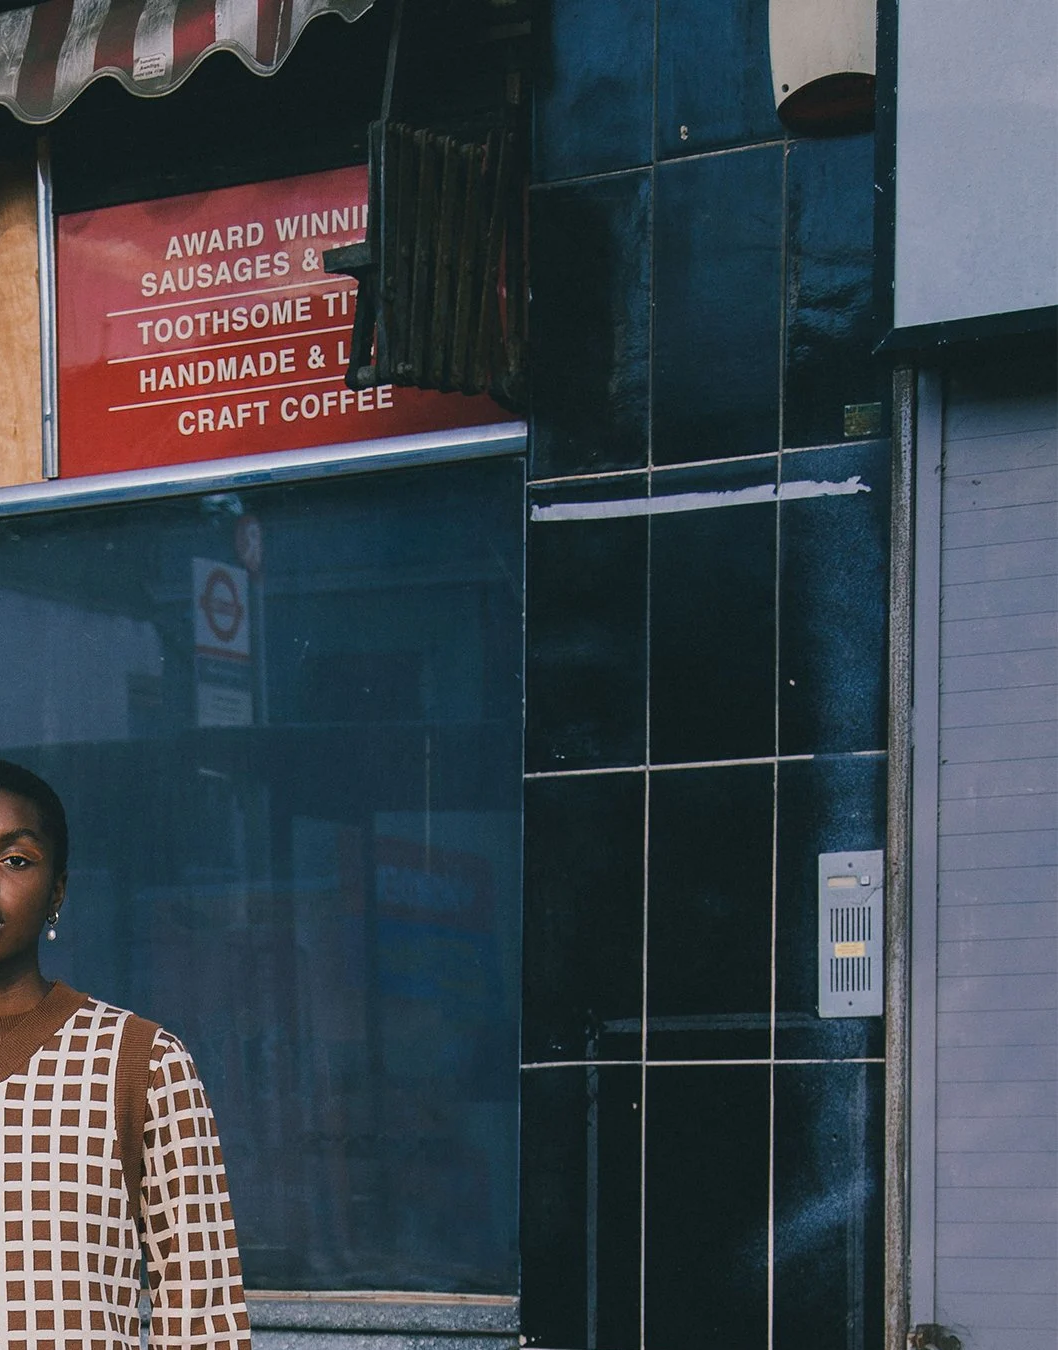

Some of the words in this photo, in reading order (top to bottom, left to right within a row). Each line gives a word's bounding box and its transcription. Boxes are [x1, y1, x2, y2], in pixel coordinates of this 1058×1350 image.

[165, 222, 264, 261] AWARD
[141, 251, 290, 297] SAUSAGES
[301, 247, 320, 272] &
[137, 296, 312, 345] TOOTHSOME
[139, 348, 296, 393] HANDMADE
[307, 345, 326, 369] &
[178, 400, 270, 436] CRAFT
[280, 384, 394, 422] COFFEE
